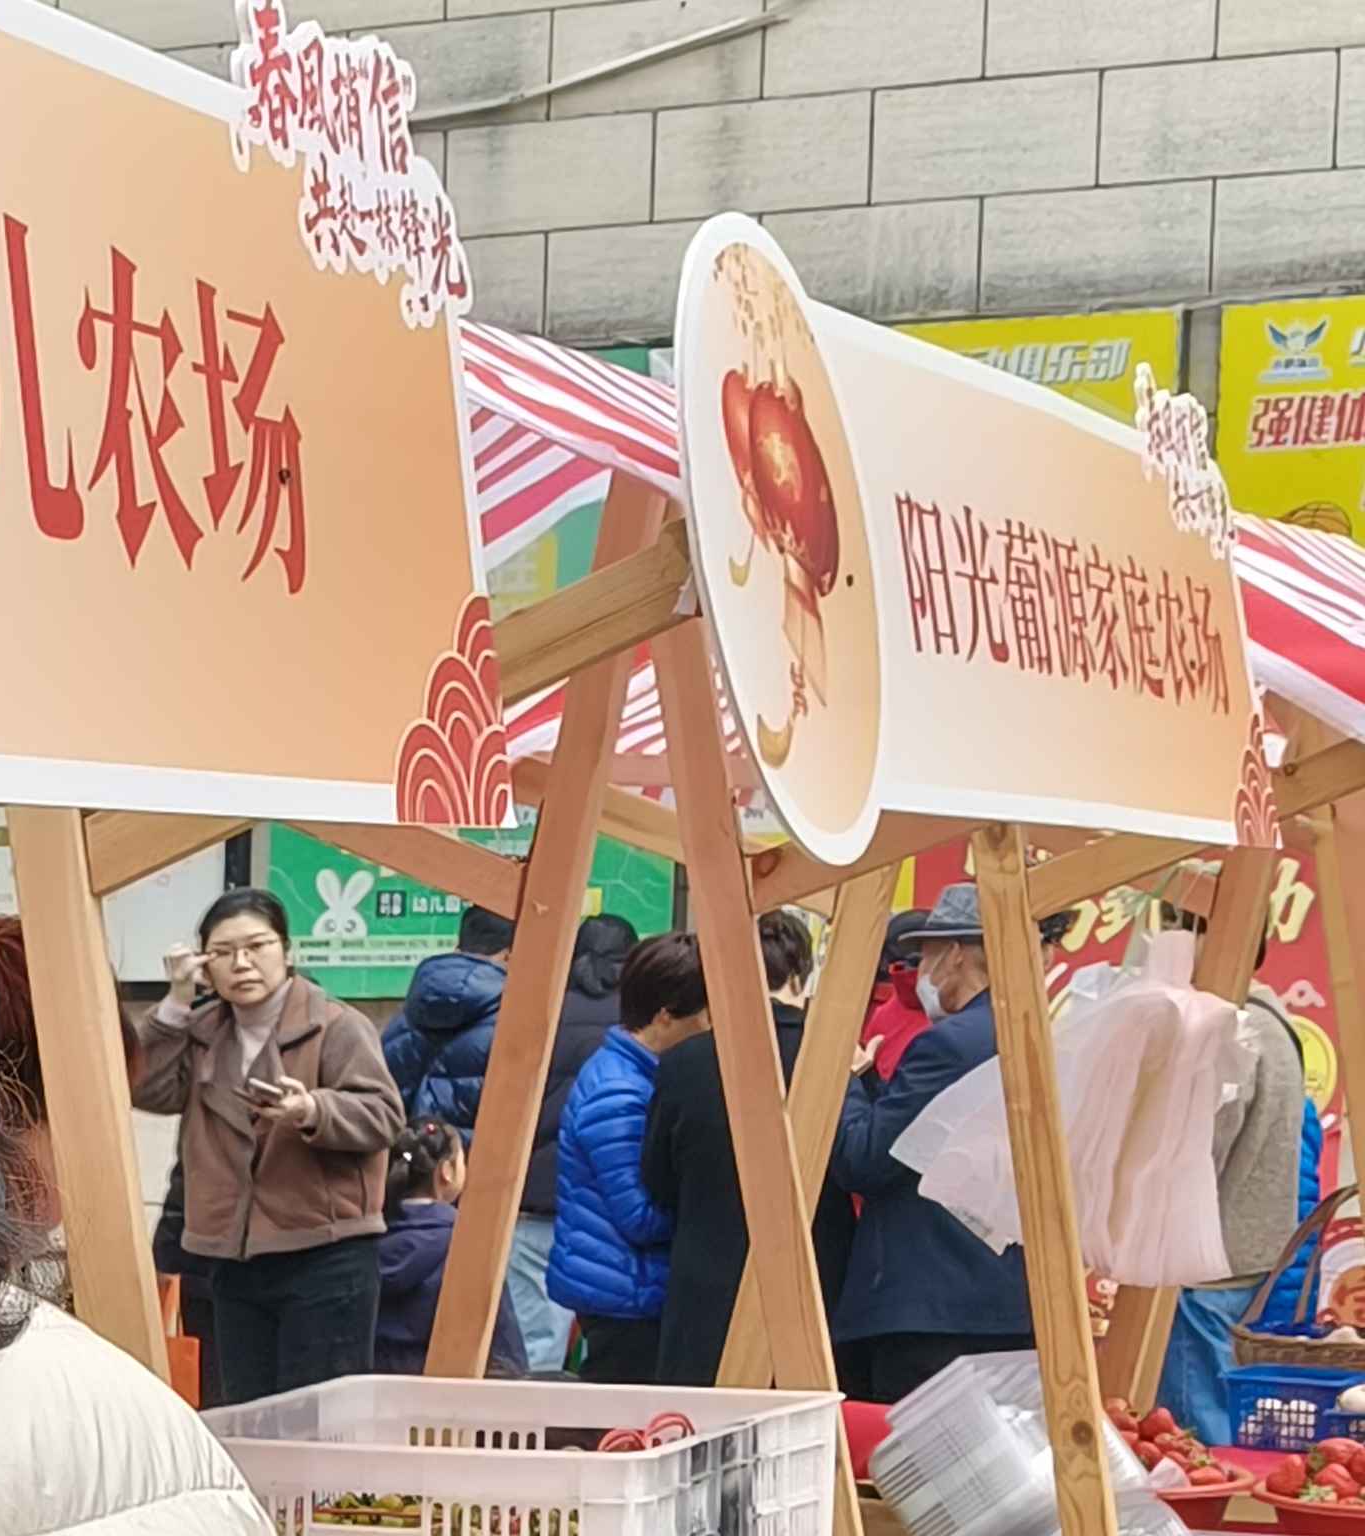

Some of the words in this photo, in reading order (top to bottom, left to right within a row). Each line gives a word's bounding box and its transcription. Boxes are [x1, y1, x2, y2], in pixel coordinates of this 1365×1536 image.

[894, 490, 1230, 715] 阳光葡源家庭农场
[412, 893, 473, 914] 幼儿园
